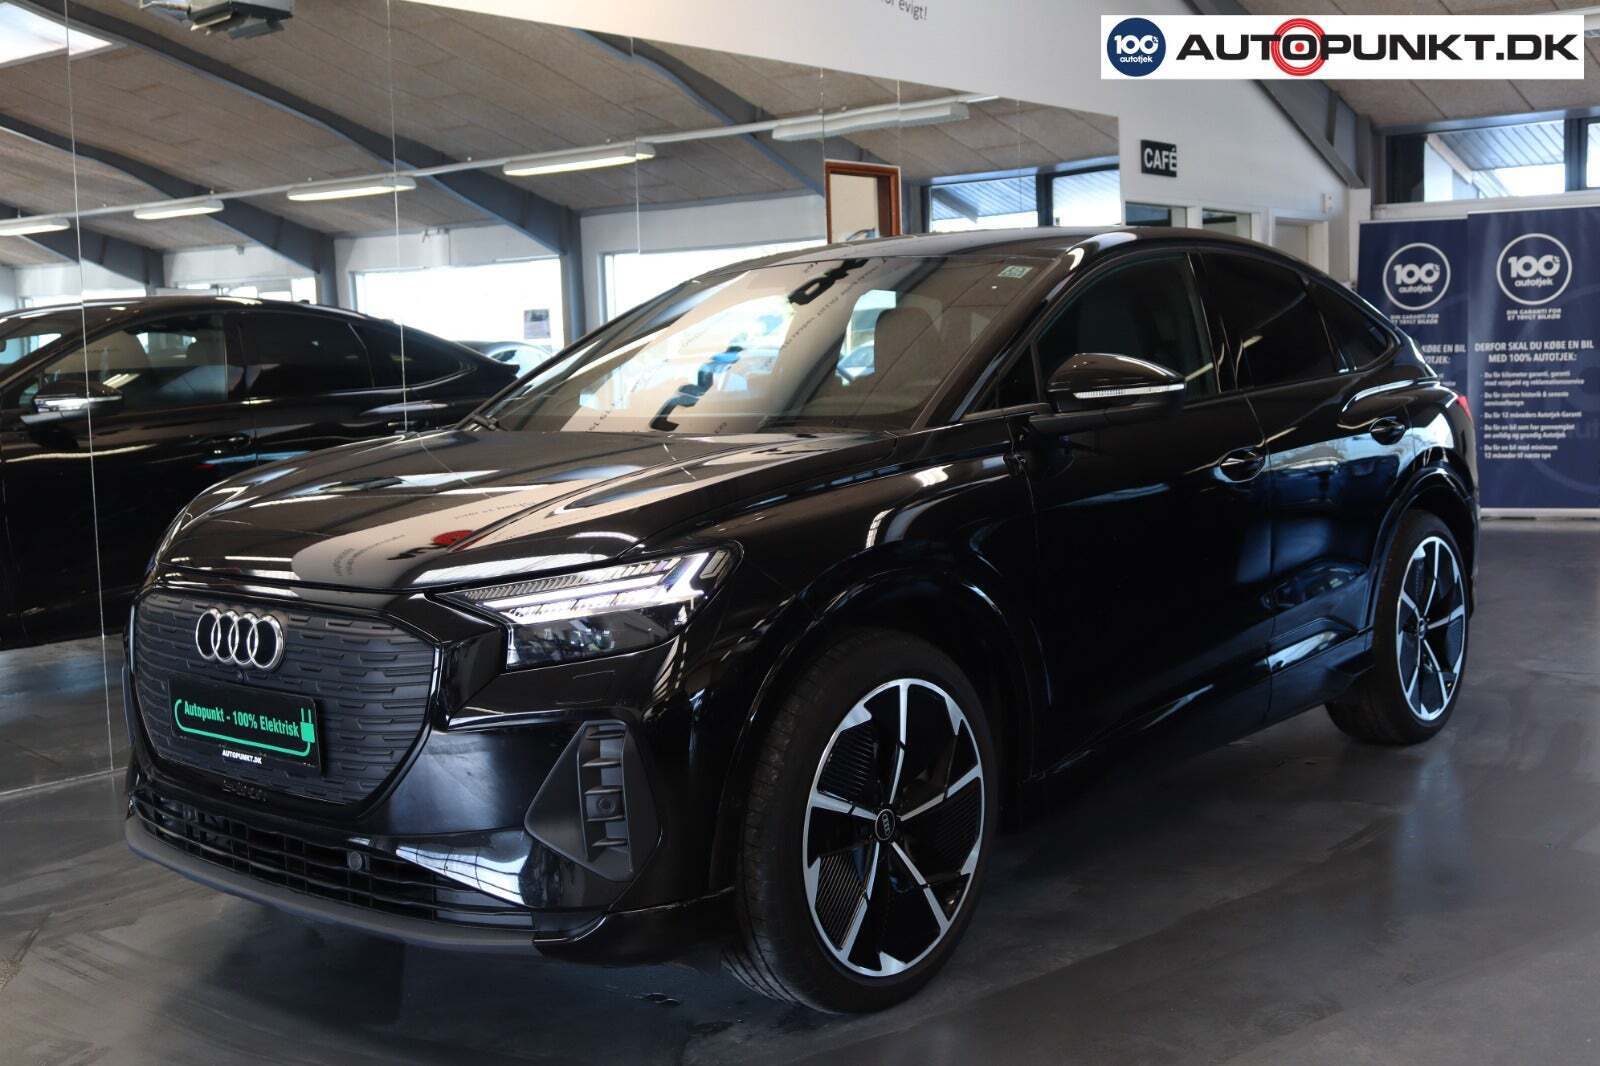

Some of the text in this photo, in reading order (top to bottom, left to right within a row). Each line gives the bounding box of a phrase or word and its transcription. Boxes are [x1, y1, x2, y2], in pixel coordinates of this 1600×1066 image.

[1144, 147, 1177, 171] CAFÉ
[1474, 339, 1594, 352] DERFOR SKAL DU KØBE EN BIL
[1488, 351, 1577, 363] MED 100% AUTOTJEK:
[184, 701, 225, 722] Autopunkt
[232, 711, 258, 729] 100%
[259, 716, 300, 738] Elektrisk
[221, 749, 263, 765] AUTOPUNKT.DK
